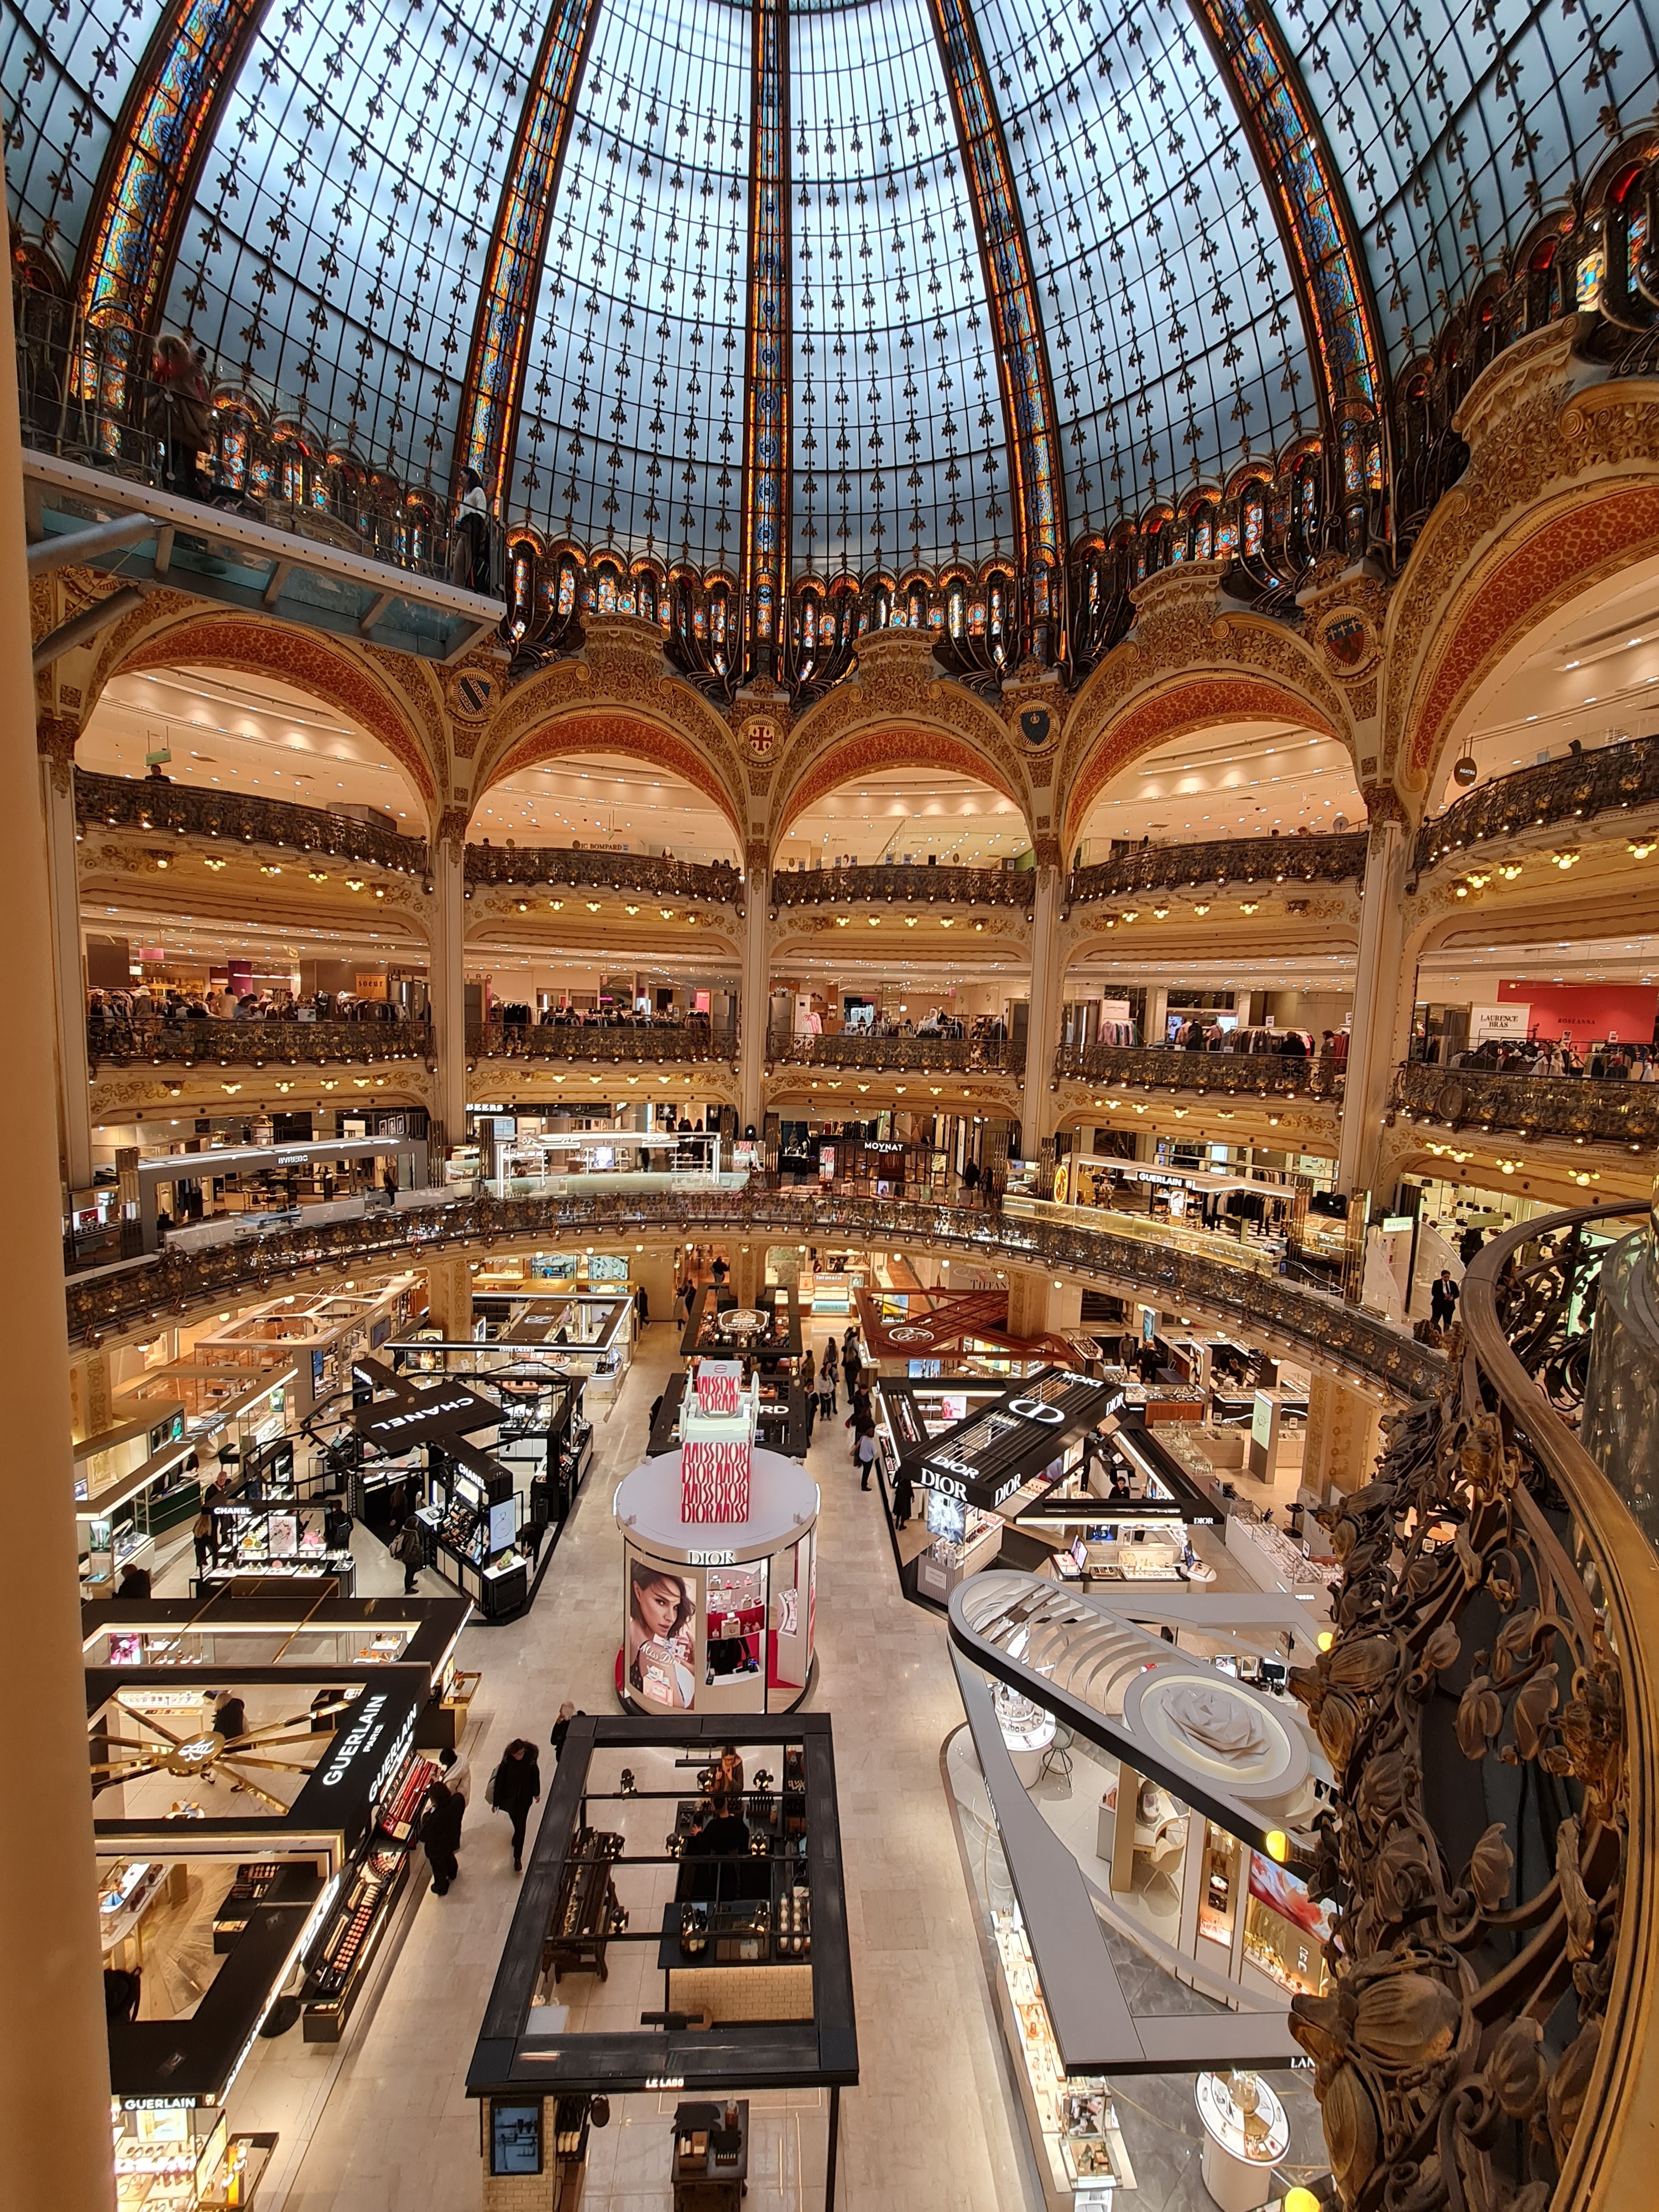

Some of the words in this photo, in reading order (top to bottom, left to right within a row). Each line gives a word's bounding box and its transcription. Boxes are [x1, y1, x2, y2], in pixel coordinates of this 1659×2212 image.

[466, 1104, 504, 1112] BEERS
[864, 1142, 904, 1151] MOYNAT
[1139, 1172, 1182, 1187] GUERLAIN
[971, 1280, 1010, 1290] TIFFAN
[353, 1366, 374, 1386] CHANEL
[1062, 1371, 1104, 1388] DIOR
[1106, 1392, 1124, 1416] DIOR
[372, 1399, 474, 1431] CHANEL
[683, 1442, 714, 1463] MISS
[716, 1442, 747, 1463] DIOR
[458, 1462, 487, 1490] CHANEL
[682, 1463, 714, 1483] DIOR
[716, 1463, 747, 1483] MISS
[930, 1455, 979, 1479] DIOR
[682, 1483, 714, 1504] MISS
[716, 1483, 747, 1504] DIOR
[920, 1468, 968, 1502] DIOR
[994, 1473, 1021, 1507] DIOR
[213, 1506, 253, 1515] CHANEL
[681, 1503, 714, 1523] DIOR
[714, 1503, 746, 1523] MISS
[687, 1550, 736, 1566] DIOR
[637, 1642, 659, 1660] Miss
[322, 1694, 389, 1786] GUERLAIN
[363, 1723, 384, 1753] PARIS
[369, 1703, 418, 1803] GUERLAIN
[645, 2078, 658, 2088] LE
[124, 2097, 196, 2110] GUERLAIN
